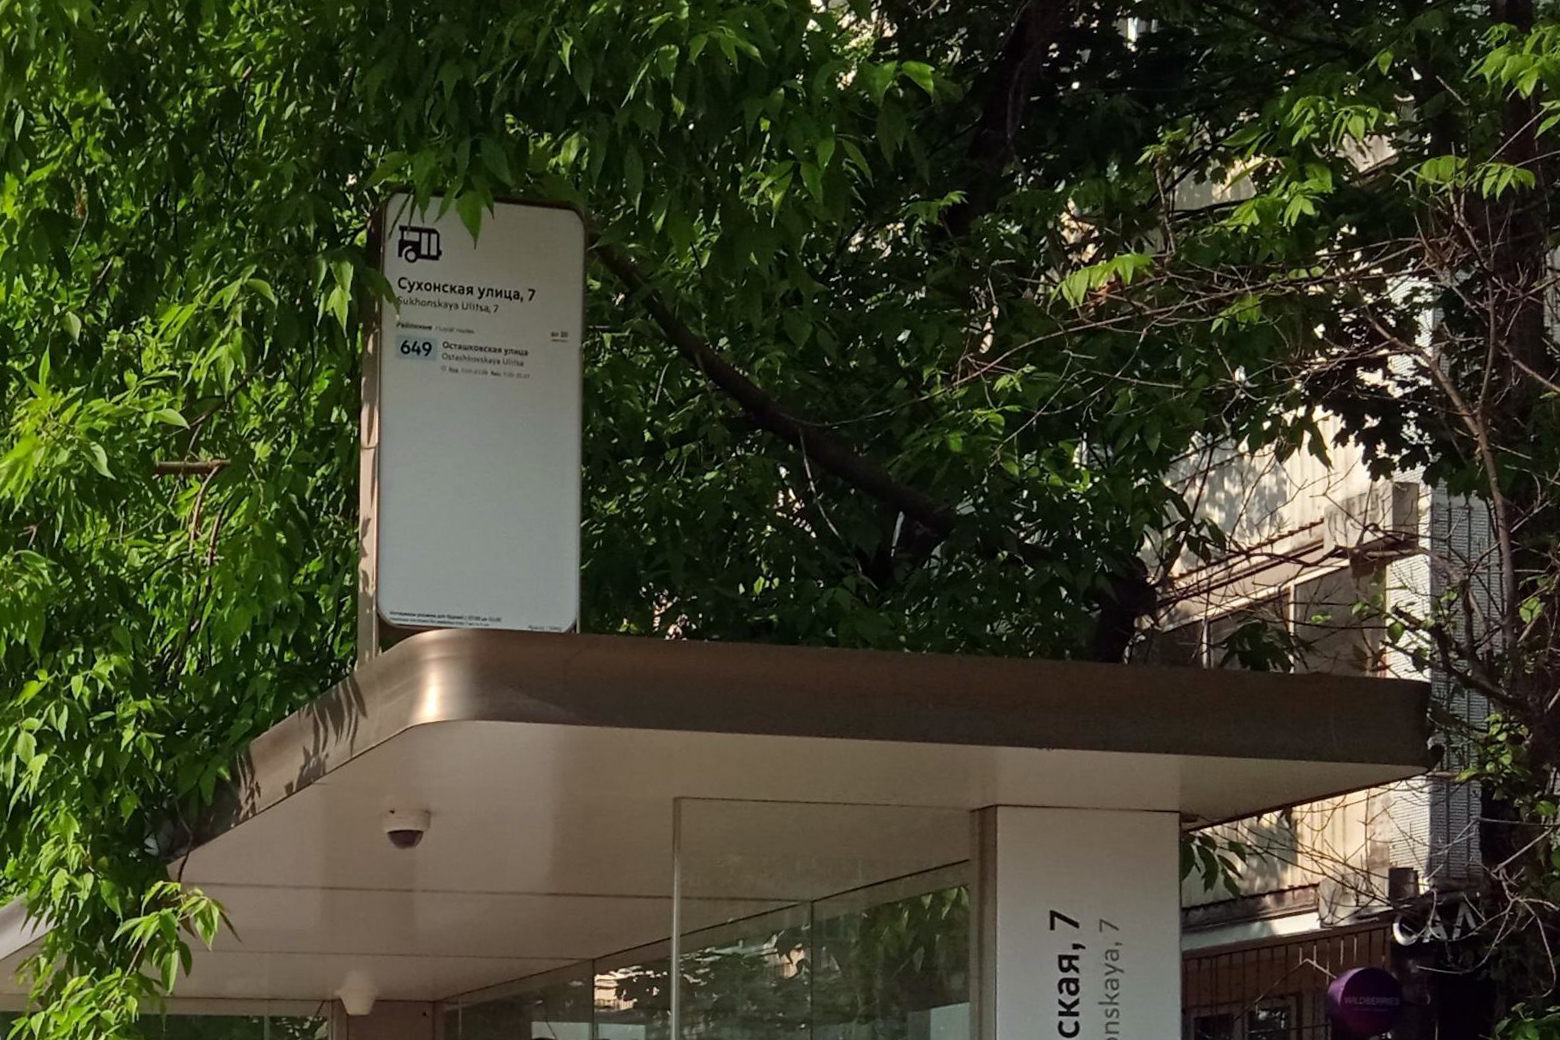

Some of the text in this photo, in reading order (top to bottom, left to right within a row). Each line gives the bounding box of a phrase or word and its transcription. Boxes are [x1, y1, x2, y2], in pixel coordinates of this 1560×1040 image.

[397, 276, 536, 303] Сухонская улица, 7
[397, 296, 460, 313] Sukhonskaya
[400, 339, 432, 357] 649
[442, 340, 529, 358] Осташковская улица
[1049, 908, 1081, 932] 7
[1098, 918, 1120, 934] 7
